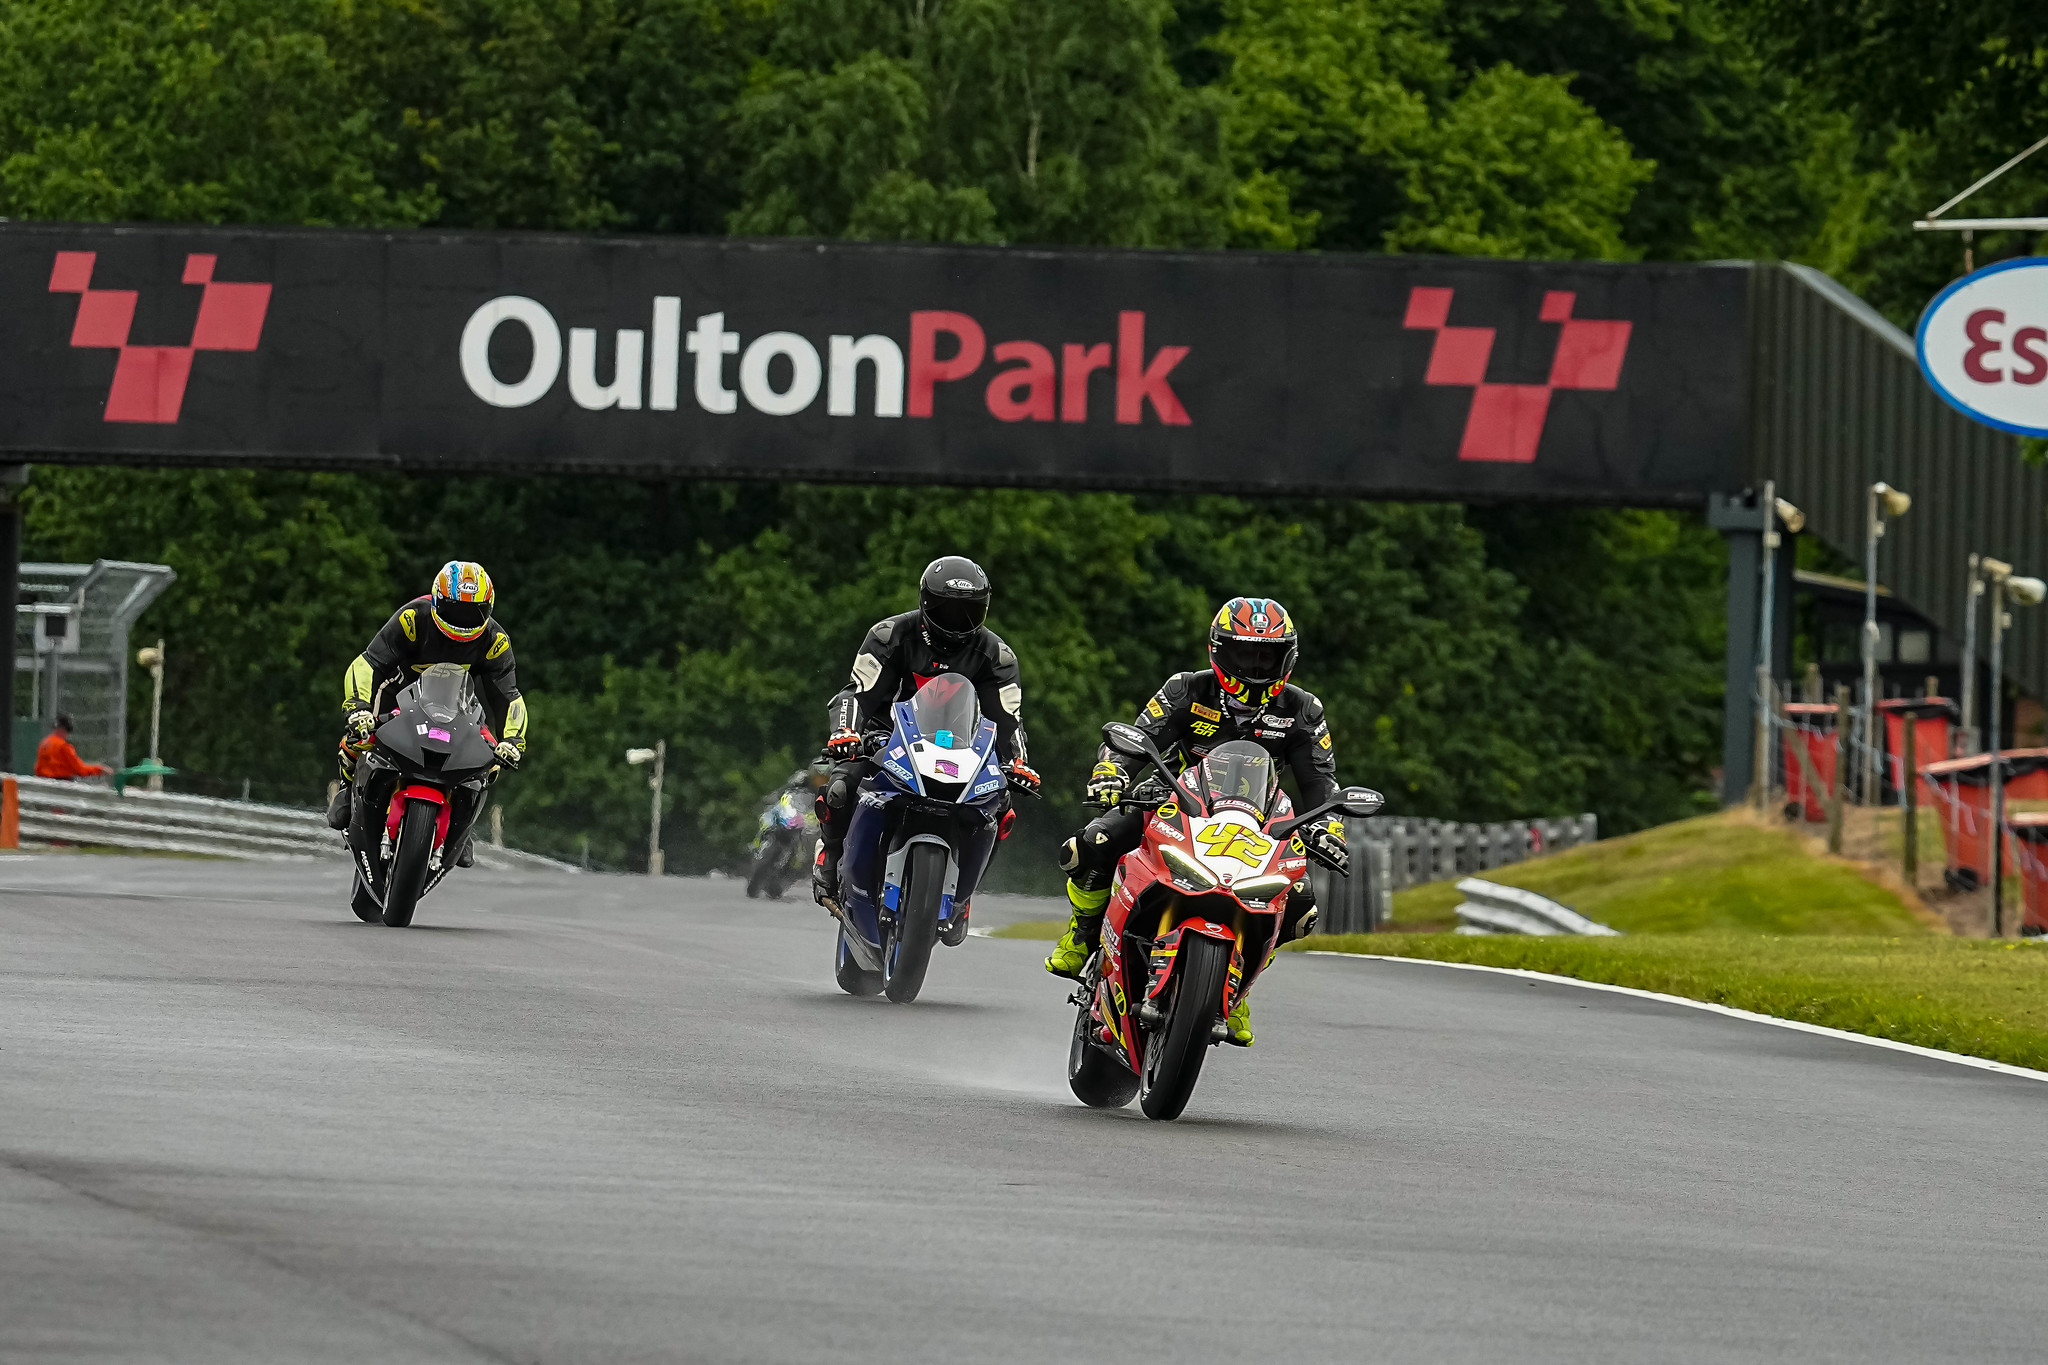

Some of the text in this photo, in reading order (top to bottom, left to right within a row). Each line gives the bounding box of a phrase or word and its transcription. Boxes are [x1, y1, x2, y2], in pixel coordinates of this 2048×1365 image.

[1157, 822, 1186, 842] DUCATI
[1196, 822, 1272, 869] 42
[360, 850, 374, 885] MOTUL
